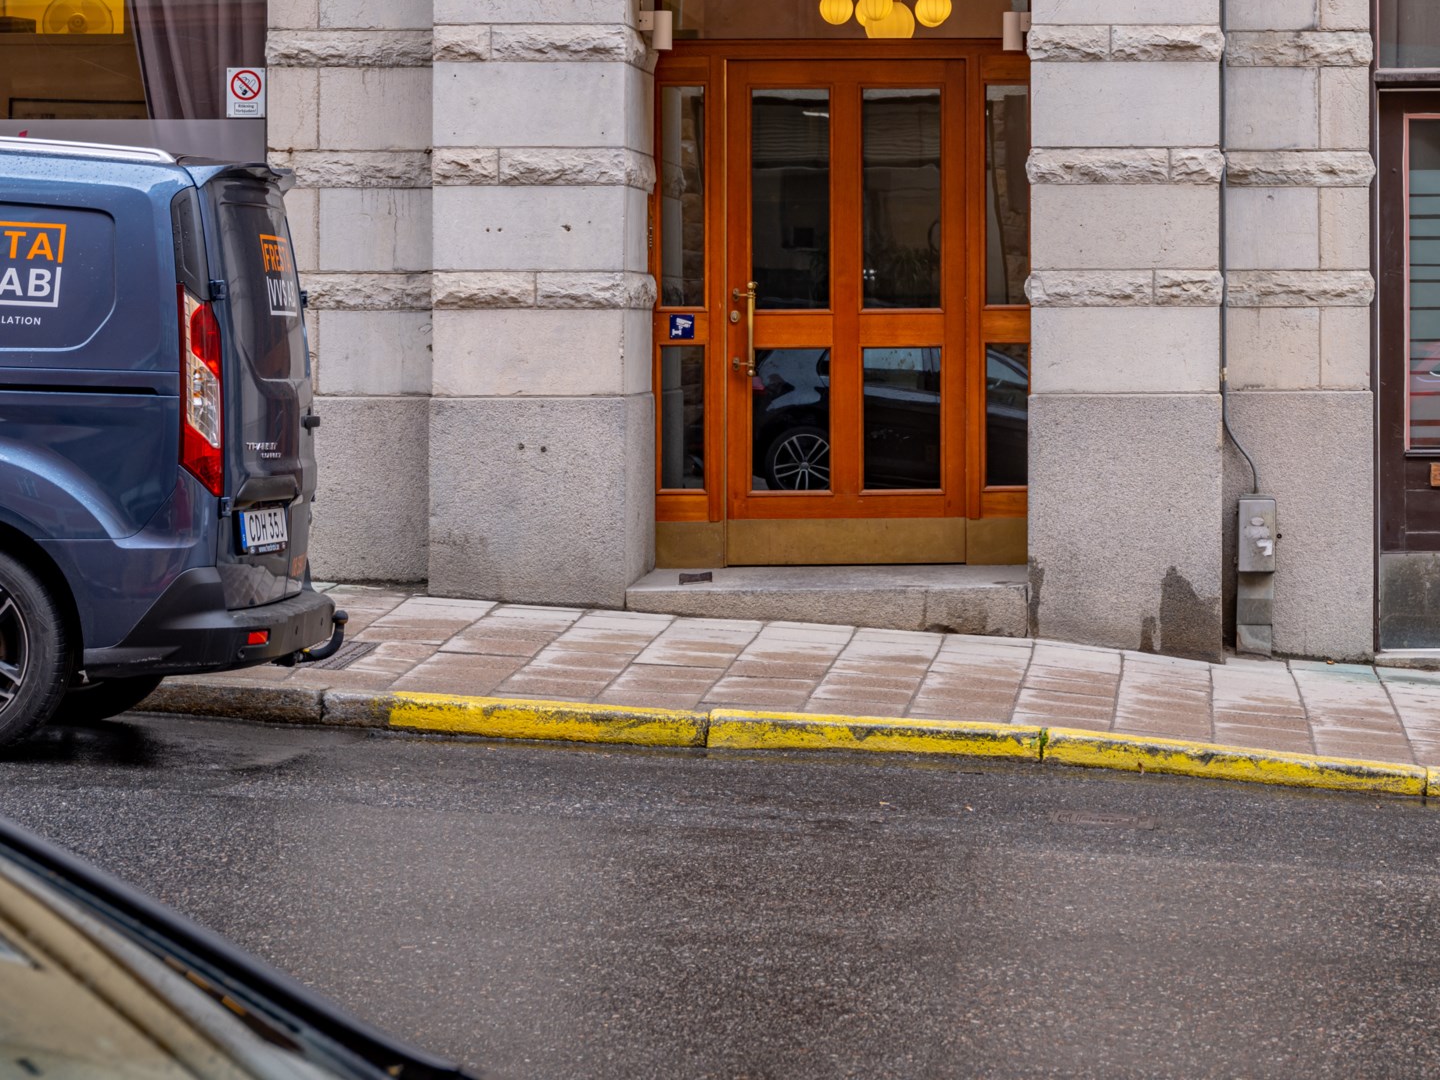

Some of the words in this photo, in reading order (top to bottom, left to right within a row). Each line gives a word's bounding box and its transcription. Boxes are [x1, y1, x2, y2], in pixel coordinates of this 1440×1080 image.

[4, 231, 54, 261] TA
[0, 268, 51, 297] AB
[1, 316, 41, 326] LATION
[249, 513, 268, 542] CDH
[268, 511, 285, 539] 35J
